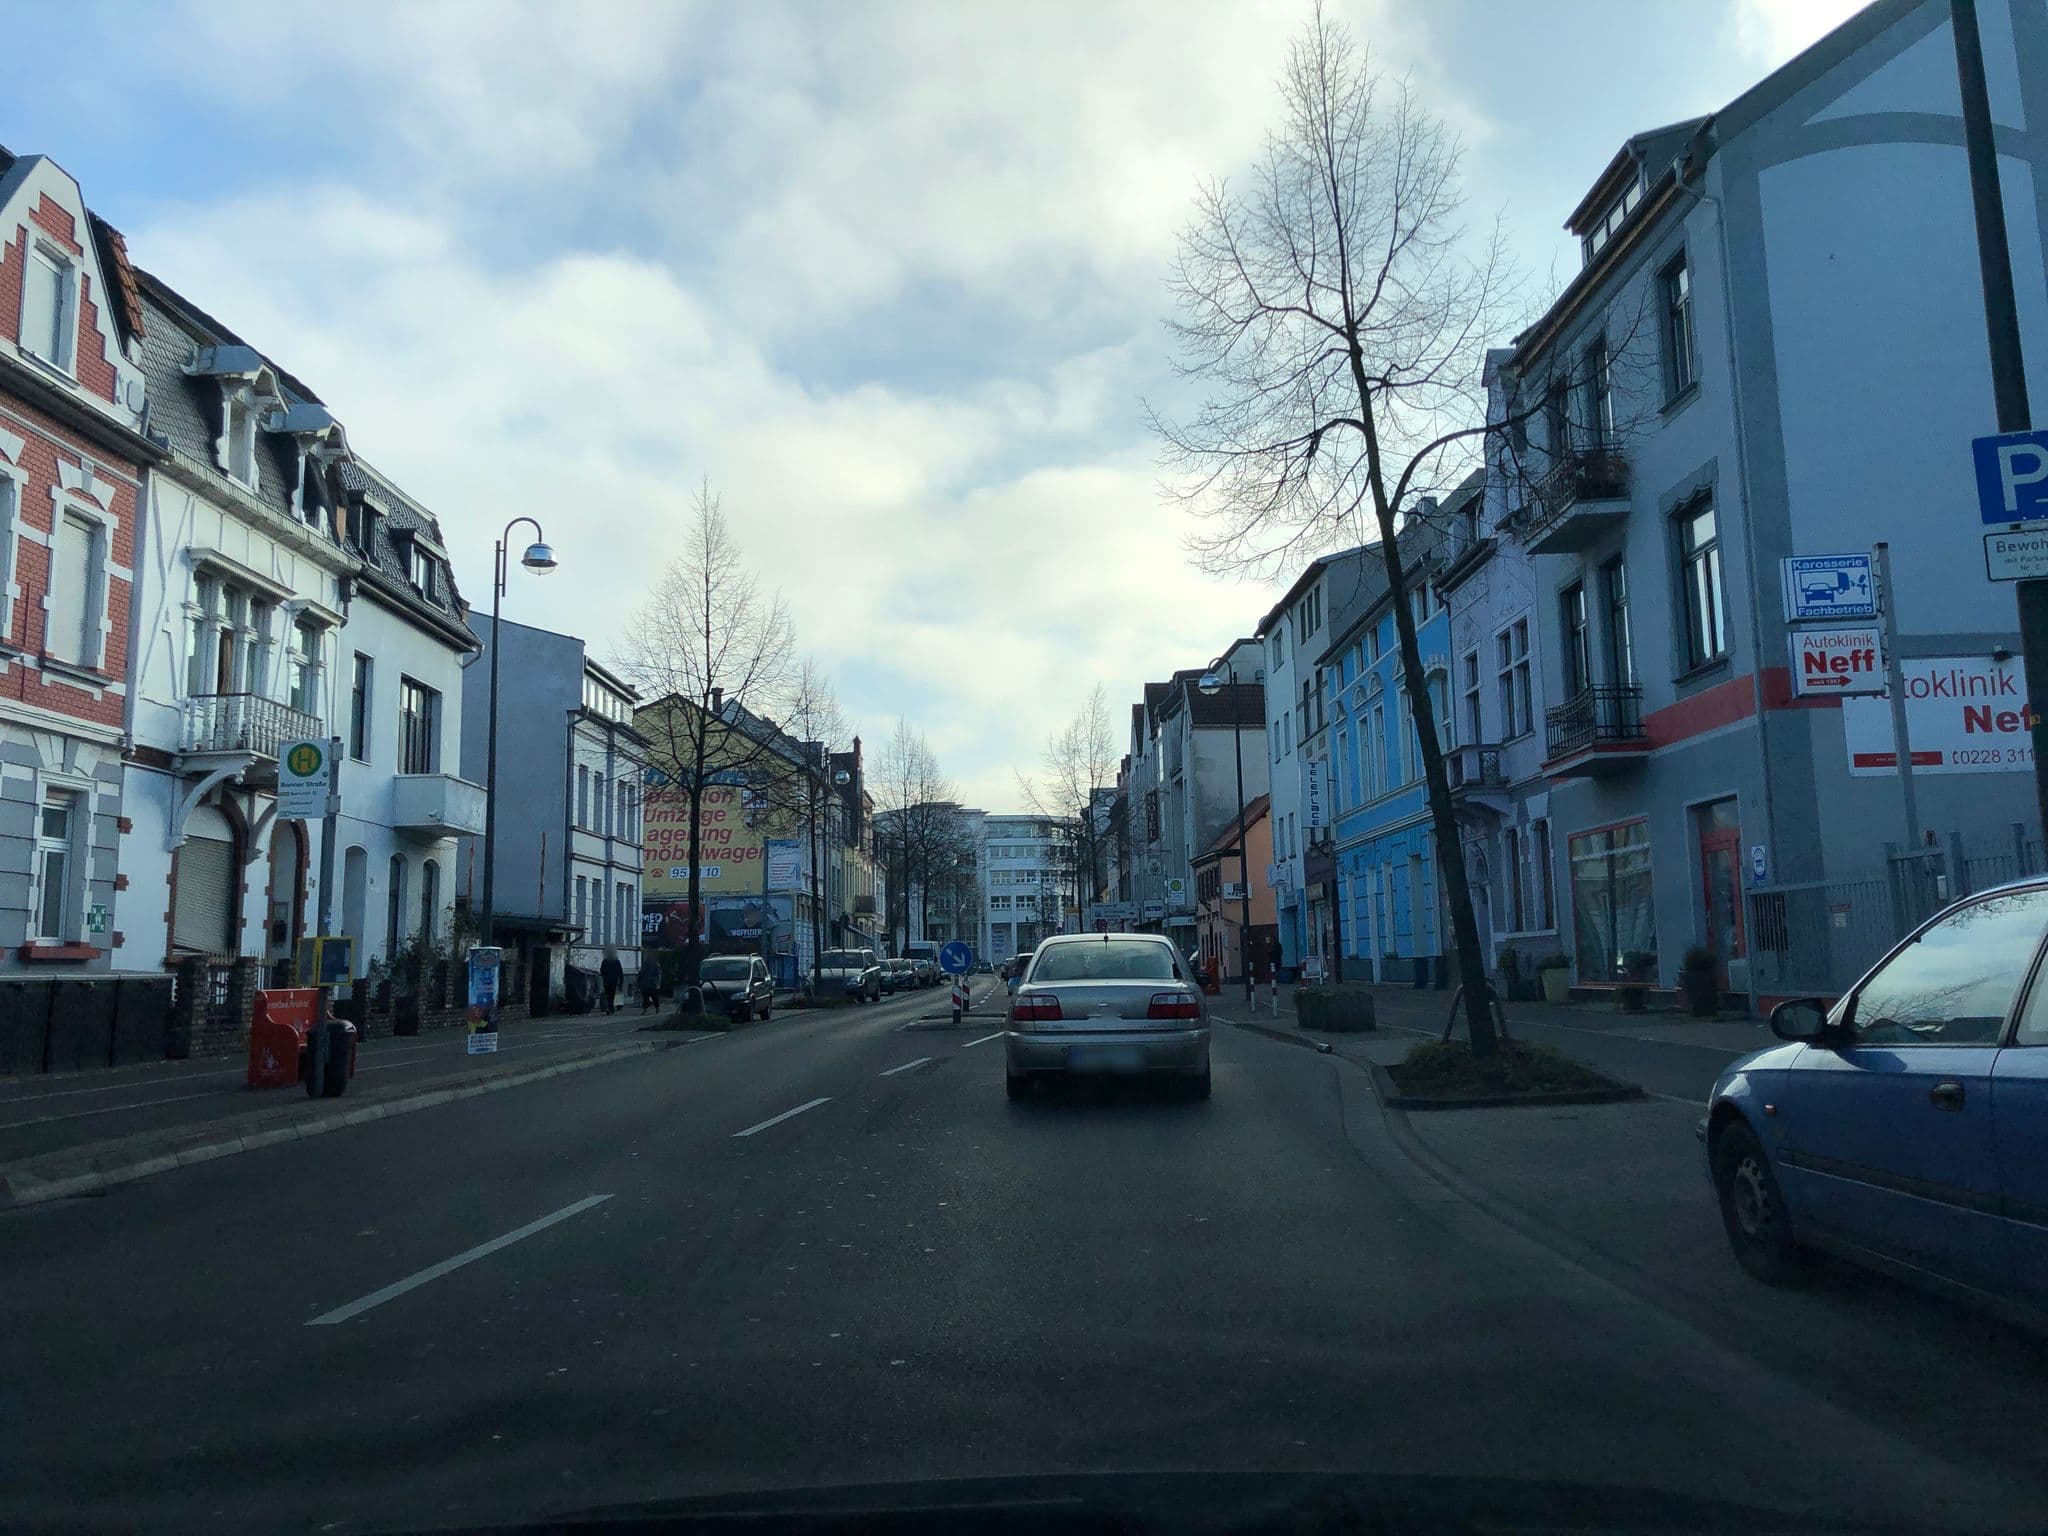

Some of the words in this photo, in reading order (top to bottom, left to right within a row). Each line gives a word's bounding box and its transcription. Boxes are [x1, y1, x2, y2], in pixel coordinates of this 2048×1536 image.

[1997, 444, 2048, 511] P
[1792, 559, 1863, 570] Karosserie
[1798, 606, 1873, 616] Fachbetrieb
[1803, 635, 1874, 648] Autoklinik
[1804, 649, 1875, 674] Neff
[1853, 669, 2018, 700] toklinik
[1963, 704, 2032, 734] Nef
[1961, 750, 2001, 764] 0228
[1308, 762, 1320, 826] TELEPLACE
[644, 807, 726, 827] Umzge
